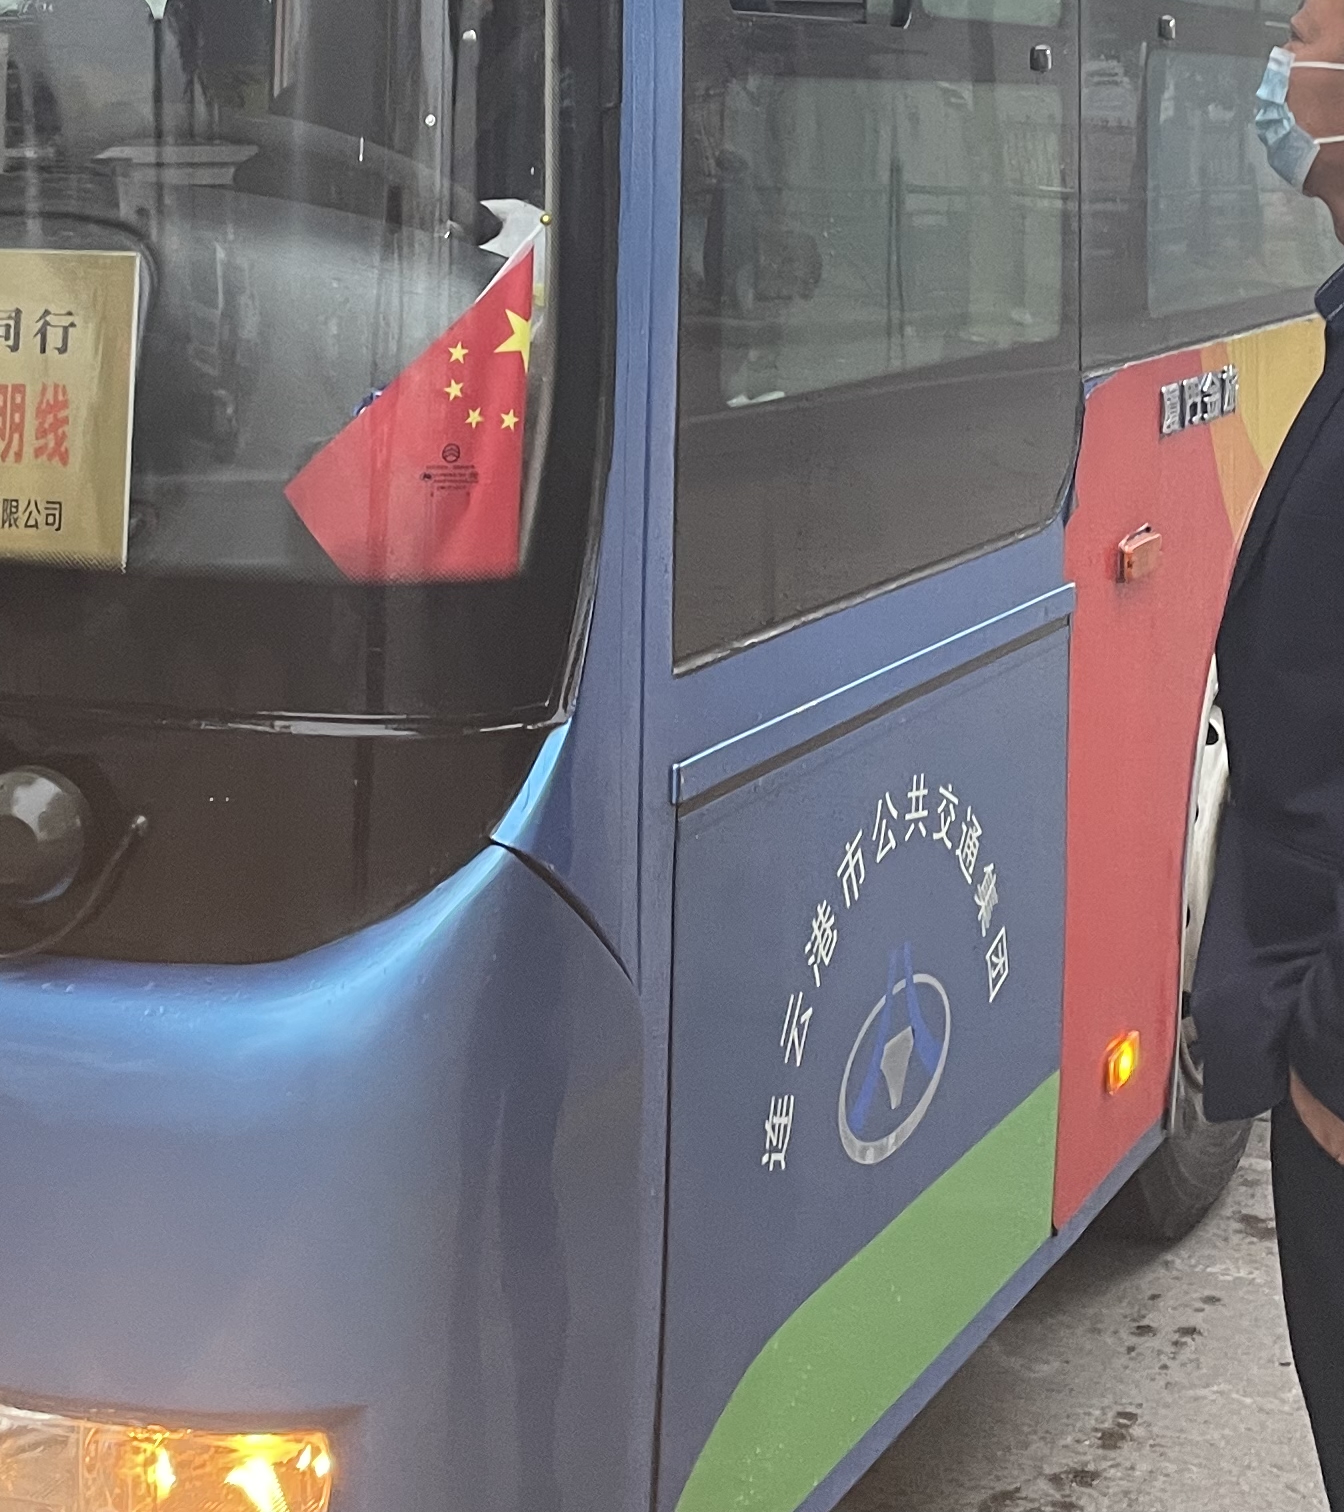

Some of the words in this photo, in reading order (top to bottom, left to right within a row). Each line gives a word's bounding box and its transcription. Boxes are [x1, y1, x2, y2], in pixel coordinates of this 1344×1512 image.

[761, 773, 1009, 1171] 连云港市公共交通集团
